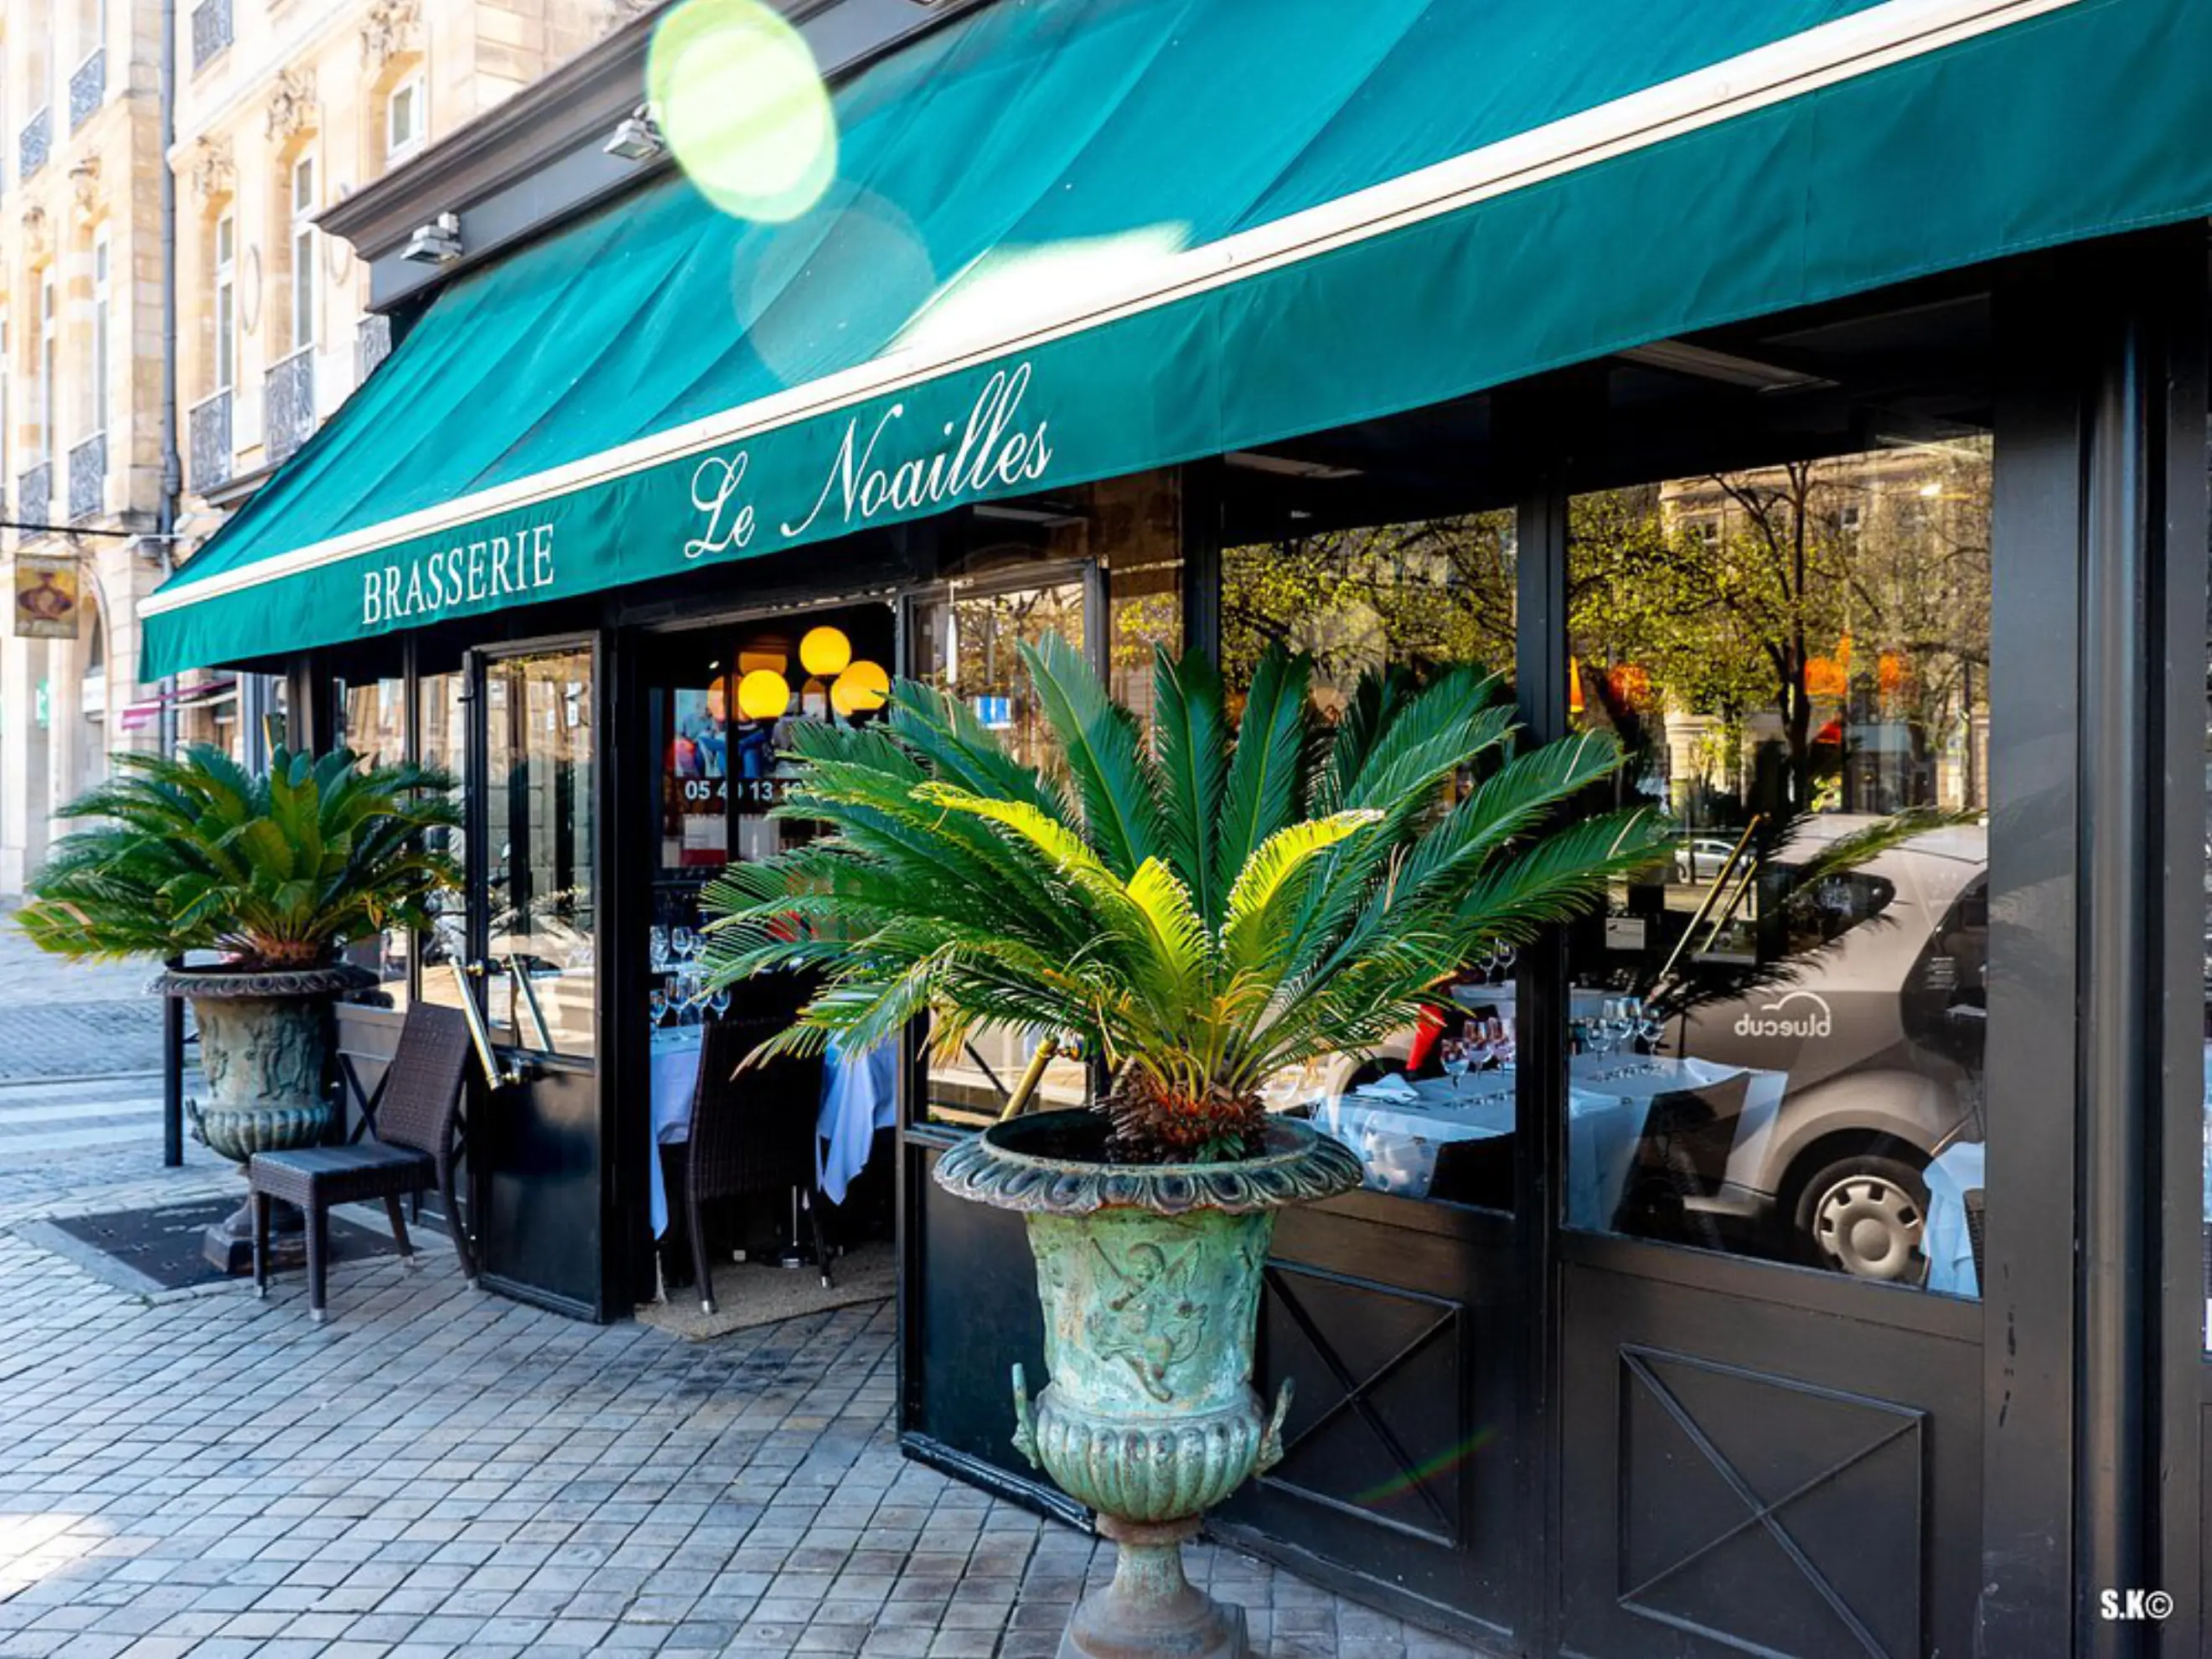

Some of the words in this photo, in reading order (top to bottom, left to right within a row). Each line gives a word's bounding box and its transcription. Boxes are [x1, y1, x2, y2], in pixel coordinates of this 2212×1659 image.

[362, 523, 555, 625] BRASSERIE
[684, 450, 756, 560] Le
[780, 361, 1054, 538] Noailles
[685, 780, 711, 800] 05
[749, 781, 773, 801] 13
